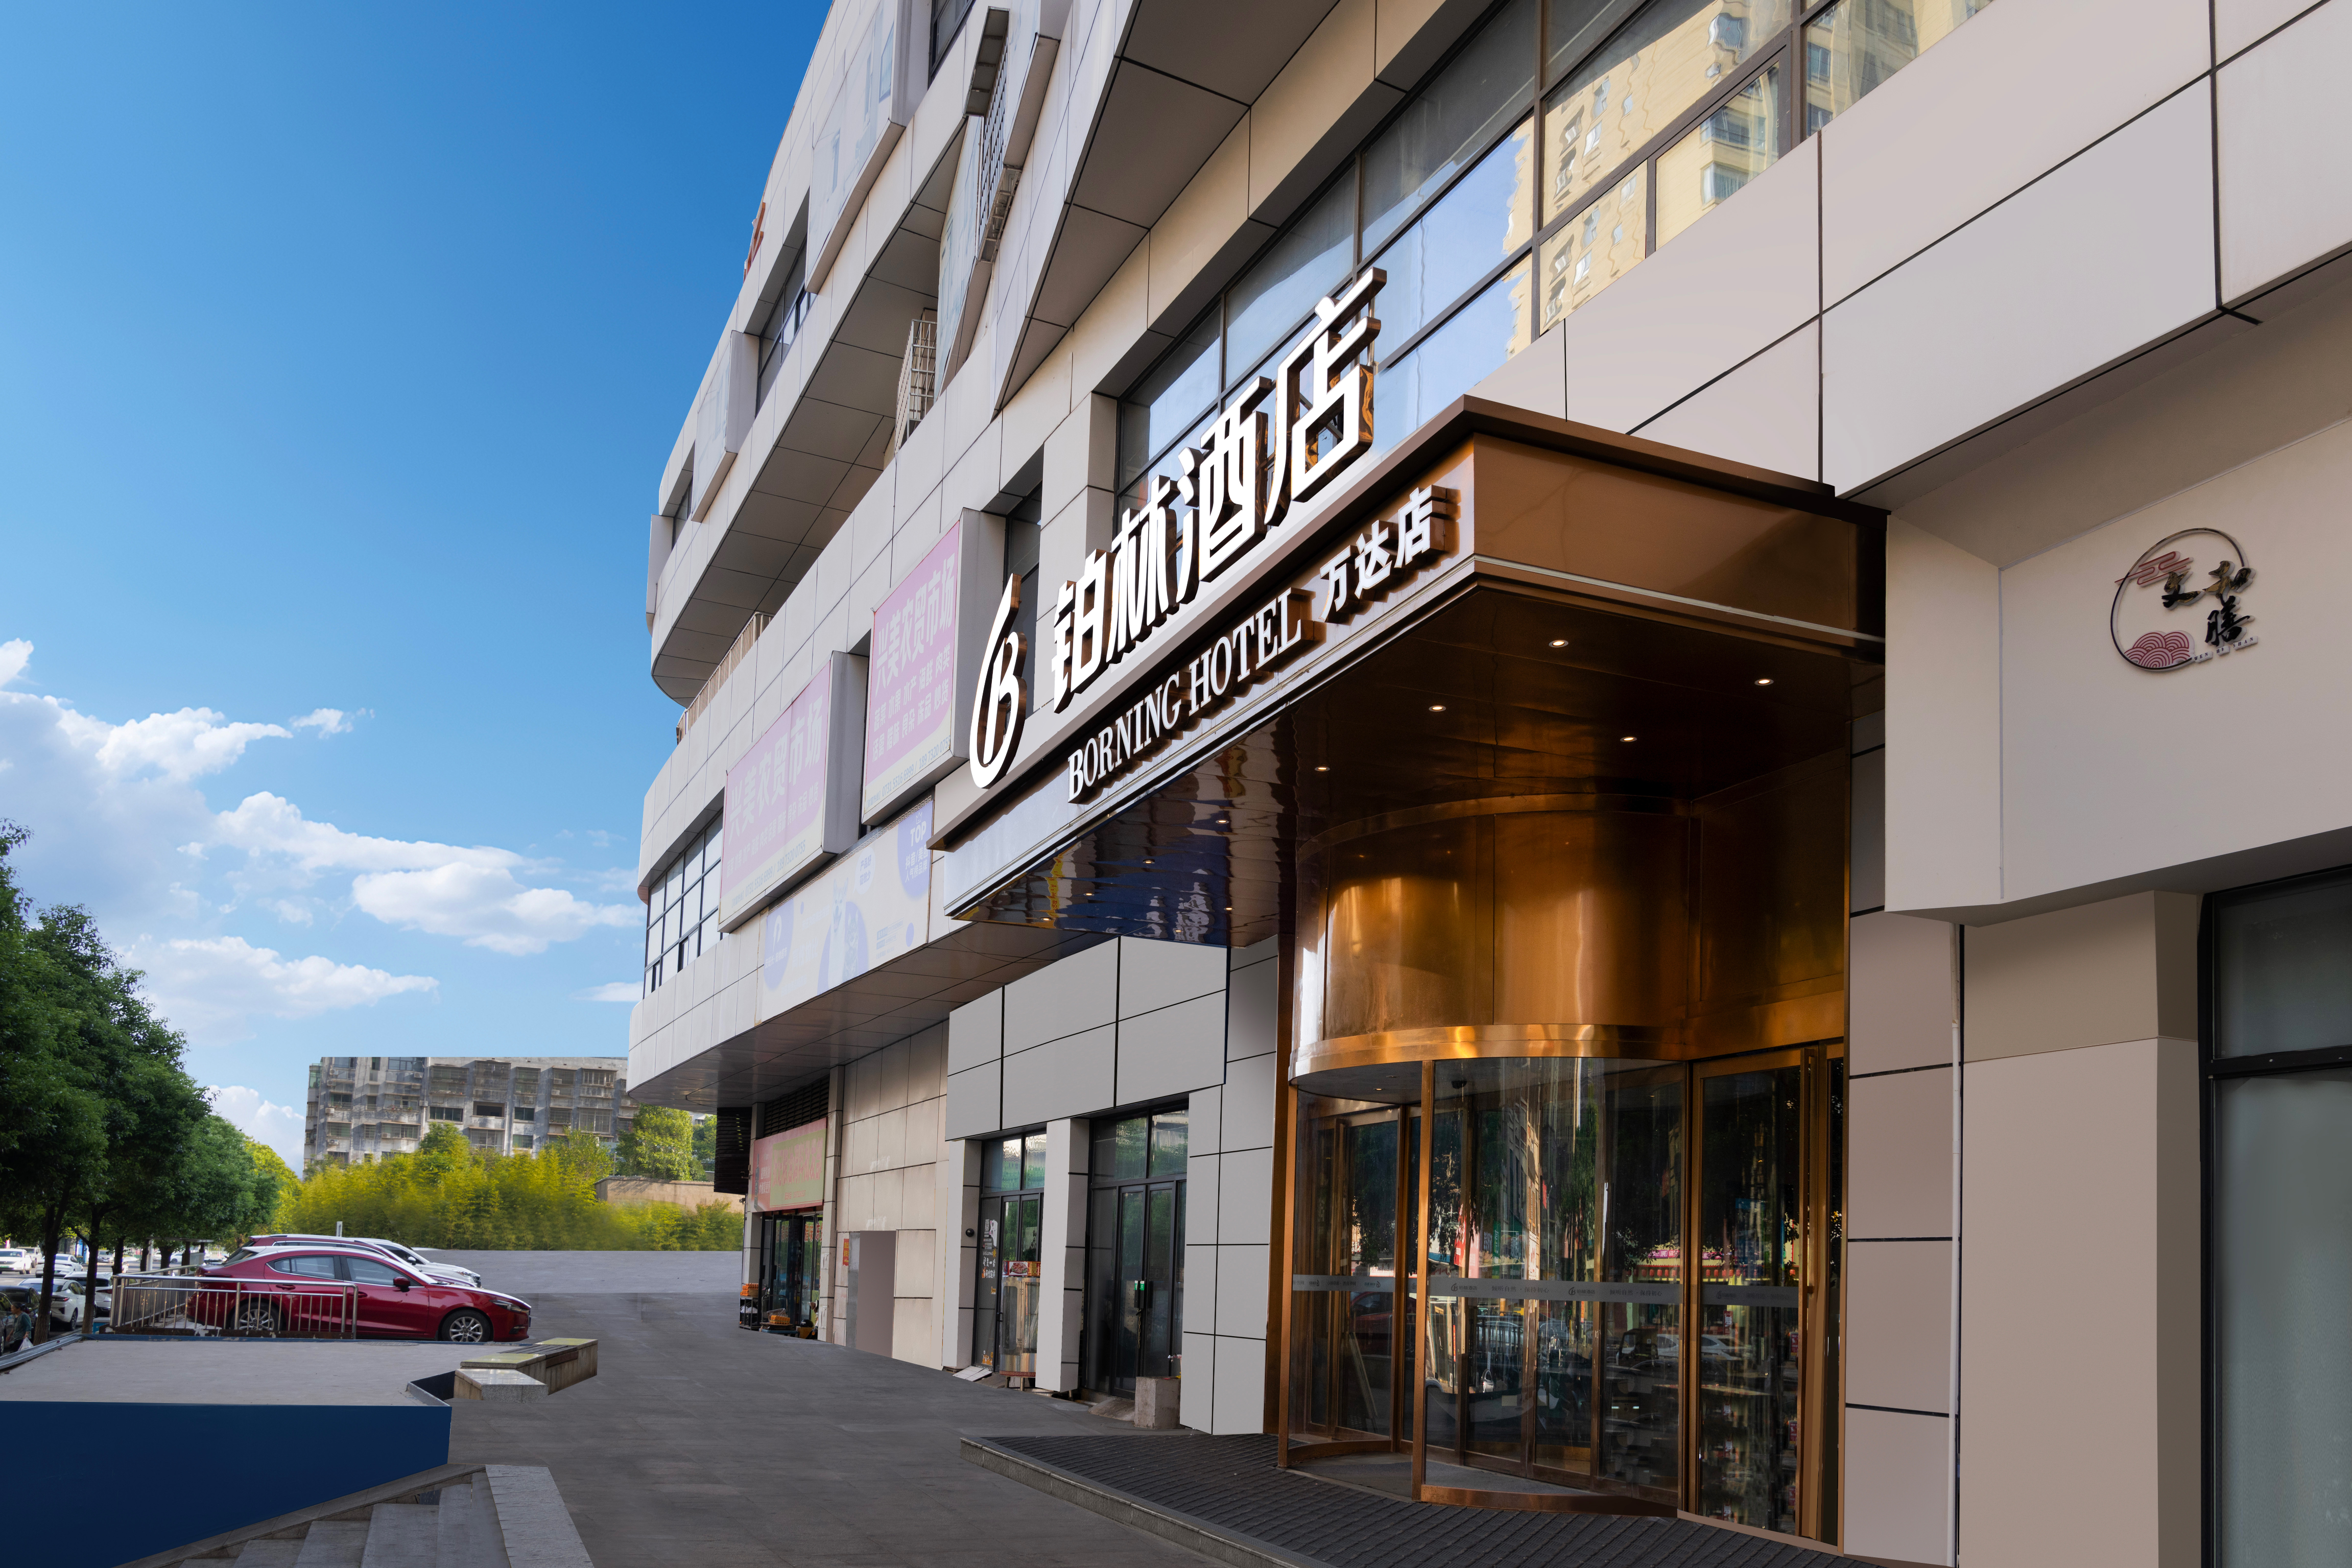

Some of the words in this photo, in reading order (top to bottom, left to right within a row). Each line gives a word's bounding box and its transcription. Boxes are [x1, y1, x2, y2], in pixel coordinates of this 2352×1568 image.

[1052, 267, 1380, 713] 铂林酒店
[1320, 485, 1434, 622] 万达店
[875, 552, 955, 693] 兴美农贸市场
[2194, 652, 2208, 661] WEN
[2232, 636, 2253, 648] SHAN
[887, 720, 899, 751] 腊味
[917, 692, 931, 726] 冻品
[934, 677, 948, 711] 炒货
[889, 688, 901, 719] 水果
[904, 675, 917, 706] 水产
[919, 658, 933, 693] 海鲜
[935, 643, 951, 678] 肉类
[1067, 673, 1180, 803] BORNING
[1189, 587, 1302, 716] HOTEL
[729, 694, 824, 846] 兴美农贸市场
[882, 781, 892, 797] 0731
[893, 772, 903, 790] 5516
[903, 764, 914, 781] 6999
[919, 755, 927, 770] 189
[928, 743, 939, 763] 7320
[745, 882, 753, 897] 0731
[754, 875, 763, 890] 5516
[764, 866, 773, 882] 6999
[785, 850, 795, 867] 7320
[795, 839, 806, 858] 0755
[860, 854, 872, 872] 产品好
[910, 821, 926, 847] TOP
[905, 860, 928, 883] 人气榜品牌
